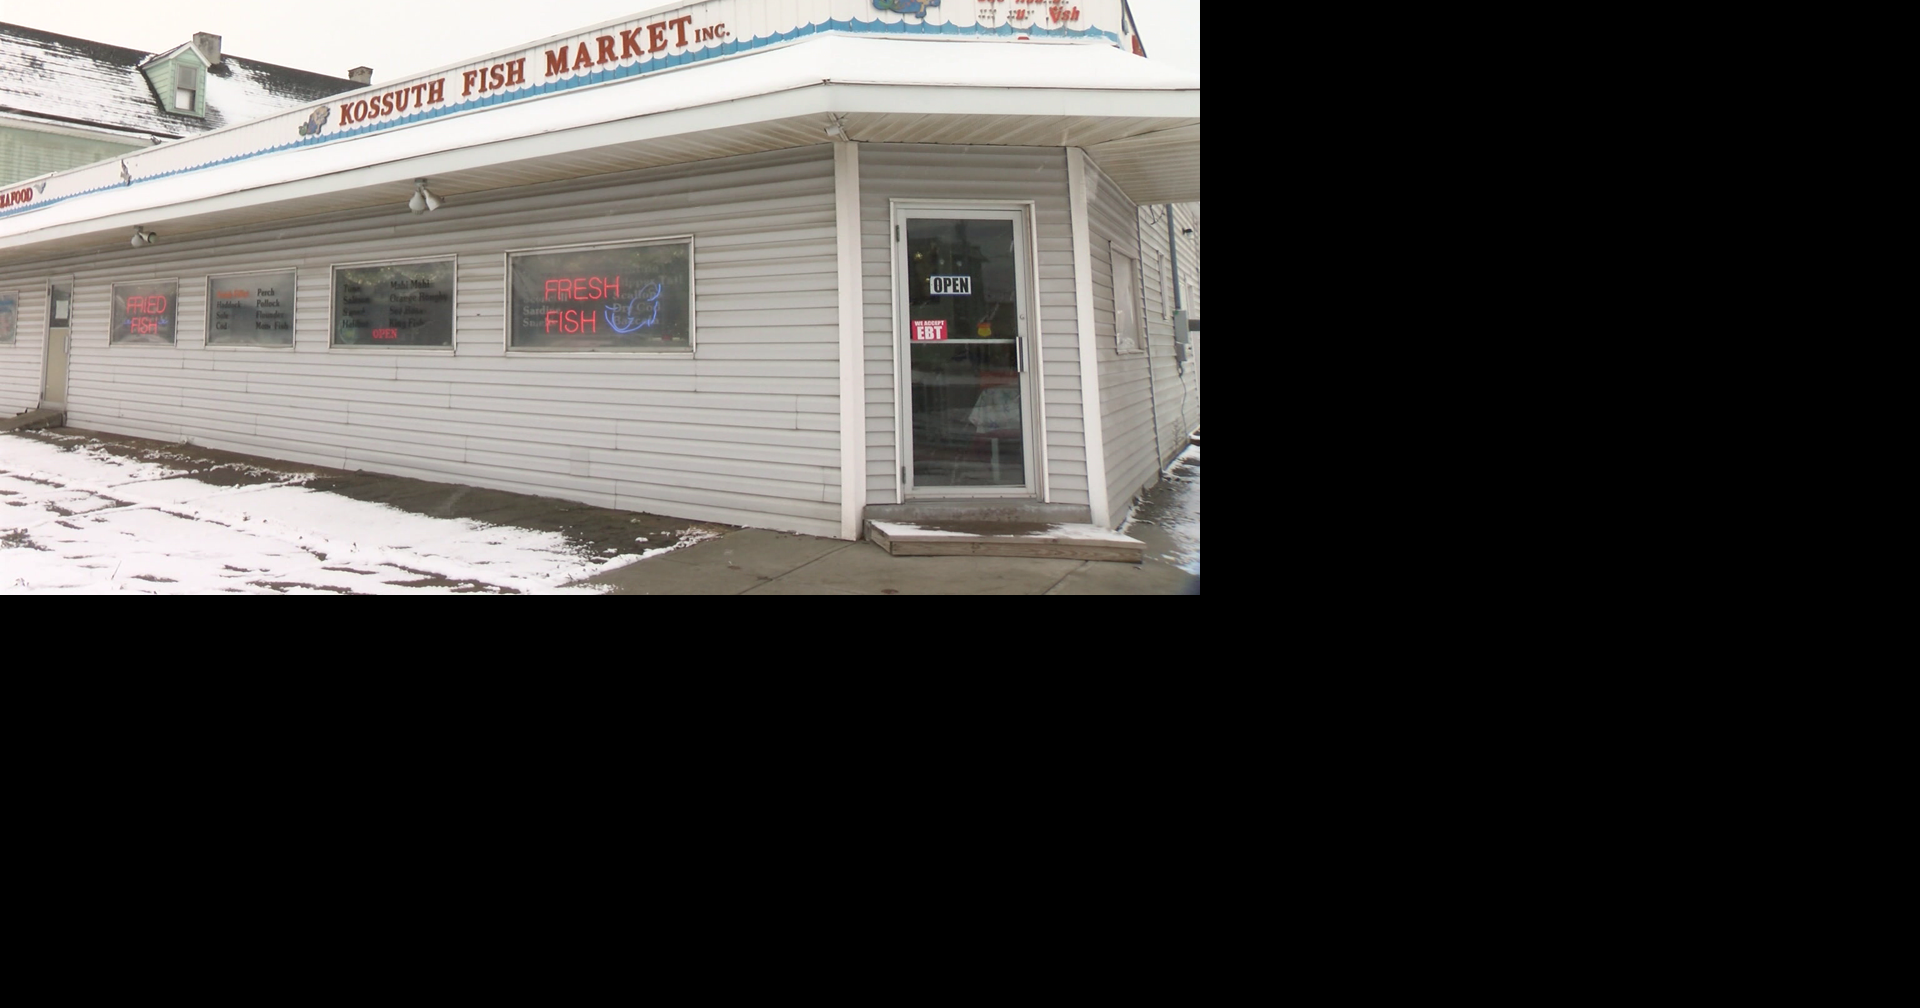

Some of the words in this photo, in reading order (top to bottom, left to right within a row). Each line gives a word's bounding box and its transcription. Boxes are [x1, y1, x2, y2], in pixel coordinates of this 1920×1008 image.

[339, 78, 445, 126] KOSSUTH
[462, 58, 526, 97] FISH
[544, 15, 692, 77] MARKET
[695, 23, 731, 43] INC.
[0, 187, 33, 209] EAFOOD
[544, 276, 620, 300] FRESH
[933, 277, 969, 293] OPEN
[257, 288, 275, 296] Perch
[390, 293, 417, 303] Orange
[126, 295, 167, 314] FRIED
[216, 300, 241, 309] Haddock
[256, 299, 280, 307] Pollock
[256, 310, 284, 319] Flounder
[130, 317, 158, 334] FISH
[216, 321, 227, 330] Cod
[274, 321, 289, 330] Fish
[545, 310, 596, 333] FISH
[372, 328, 398, 339] OPEN
[917, 326, 943, 340] EBT
